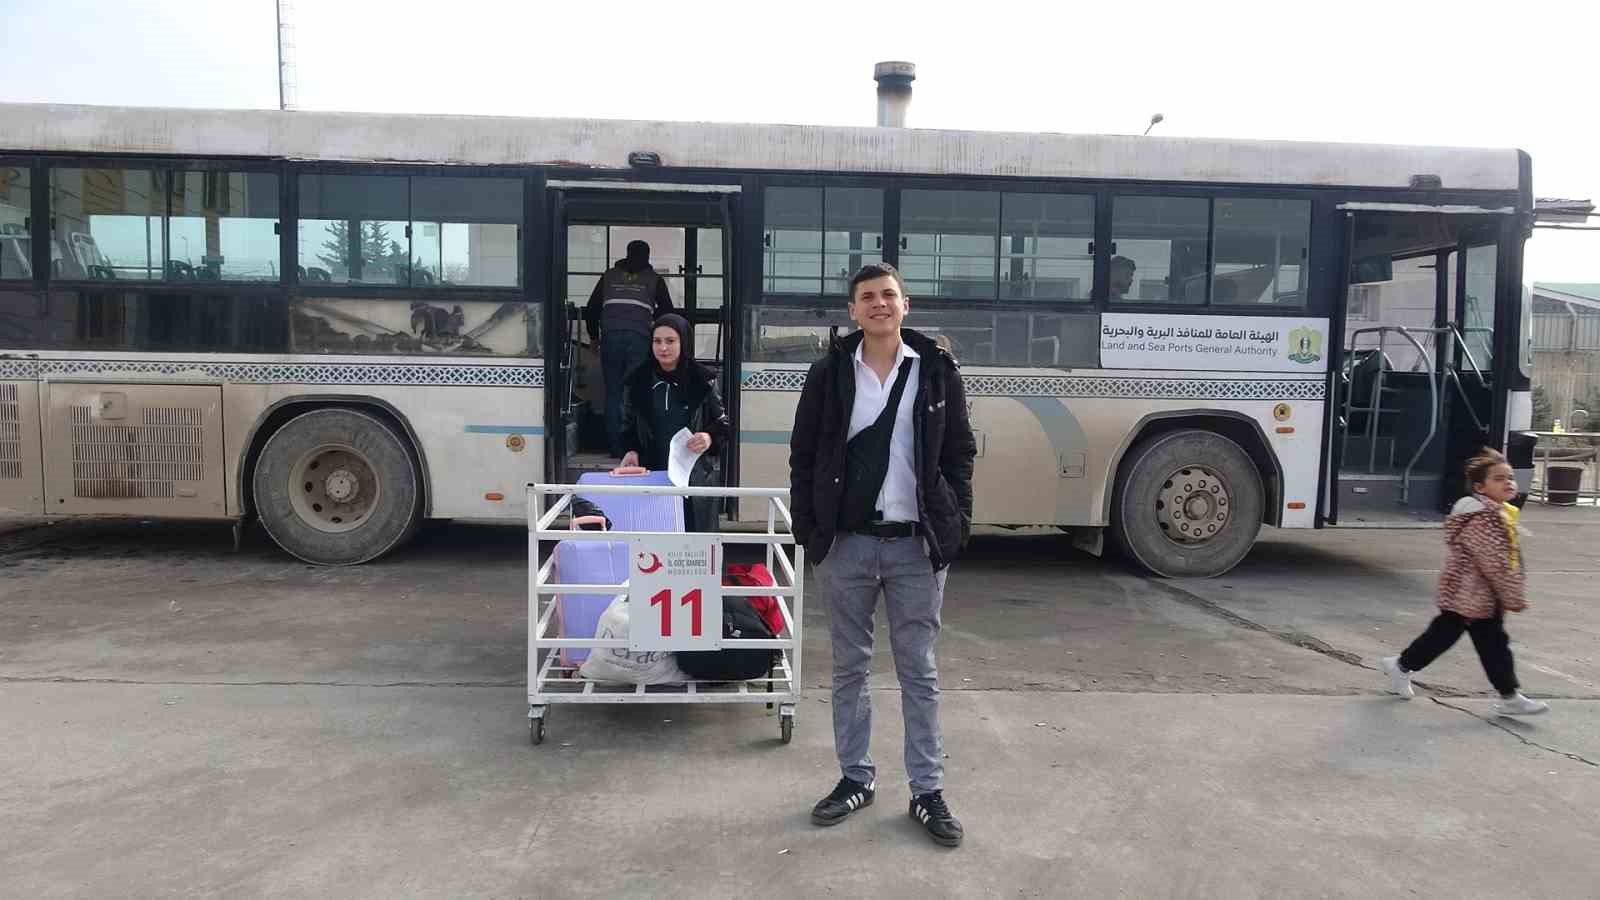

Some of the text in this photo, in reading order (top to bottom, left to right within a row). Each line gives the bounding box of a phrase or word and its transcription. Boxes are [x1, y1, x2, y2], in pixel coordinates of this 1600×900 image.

[1102, 325, 1279, 343] الهيئة العامة للمنافذ البرية والبحرية
[1102, 341, 1278, 357] Land and Sea Ports General Authority
[650, 588, 702, 636] 11
